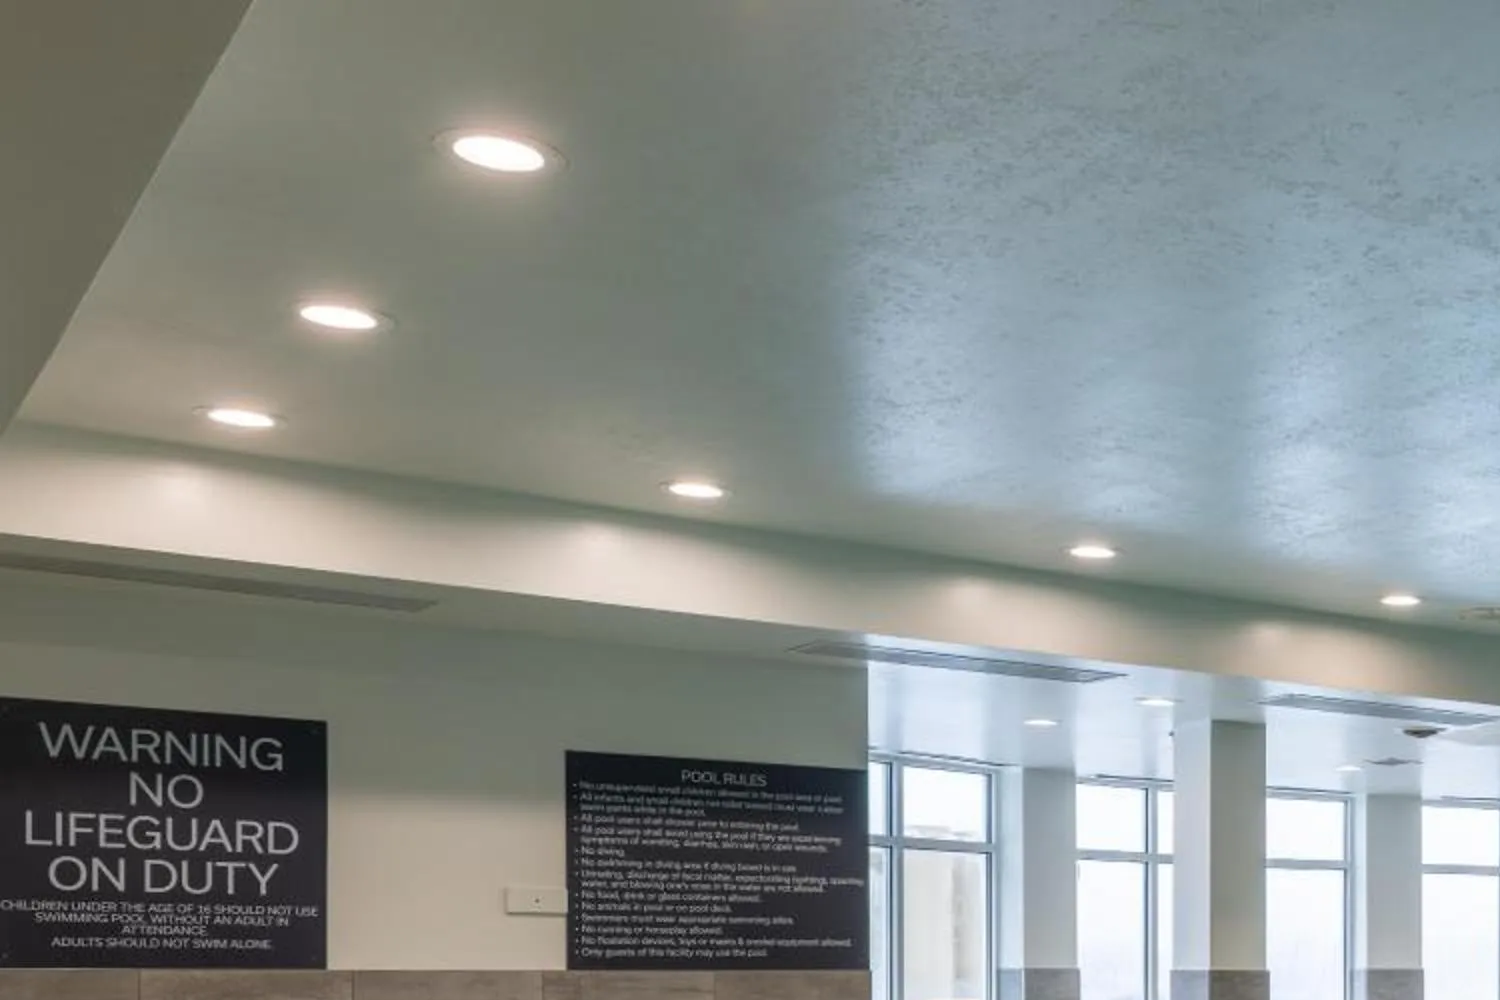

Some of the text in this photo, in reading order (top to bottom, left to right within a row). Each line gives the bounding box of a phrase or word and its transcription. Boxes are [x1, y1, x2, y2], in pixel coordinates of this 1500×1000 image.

[38, 720, 283, 772] WARNING
[681, 769, 768, 787] POOL RULES
[129, 771, 204, 809] NO
[24, 809, 299, 855] LIFEGUARD
[48, 855, 279, 896] ON DUTY
[1, 899, 68, 911] CHILDREN
[71, 901, 117, 912] UNDER
[121, 902, 145, 913] THE
[148, 902, 174, 913] AGE
[176, 903, 193, 914] OF
[213, 904, 265, 915] SHOULD
[267, 905, 293, 916] NOT
[296, 905, 319, 917] USE
[34, 911, 289, 928] SWIMMING POOL WITHOUT AN ADULT IN
[121, 924, 208, 936] ATTENDANCE
[51, 936, 104, 948] ADULTS
[106, 937, 161, 949] SHOULD
[162, 938, 189, 949] NOT
[192, 939, 228, 950] SWIM
